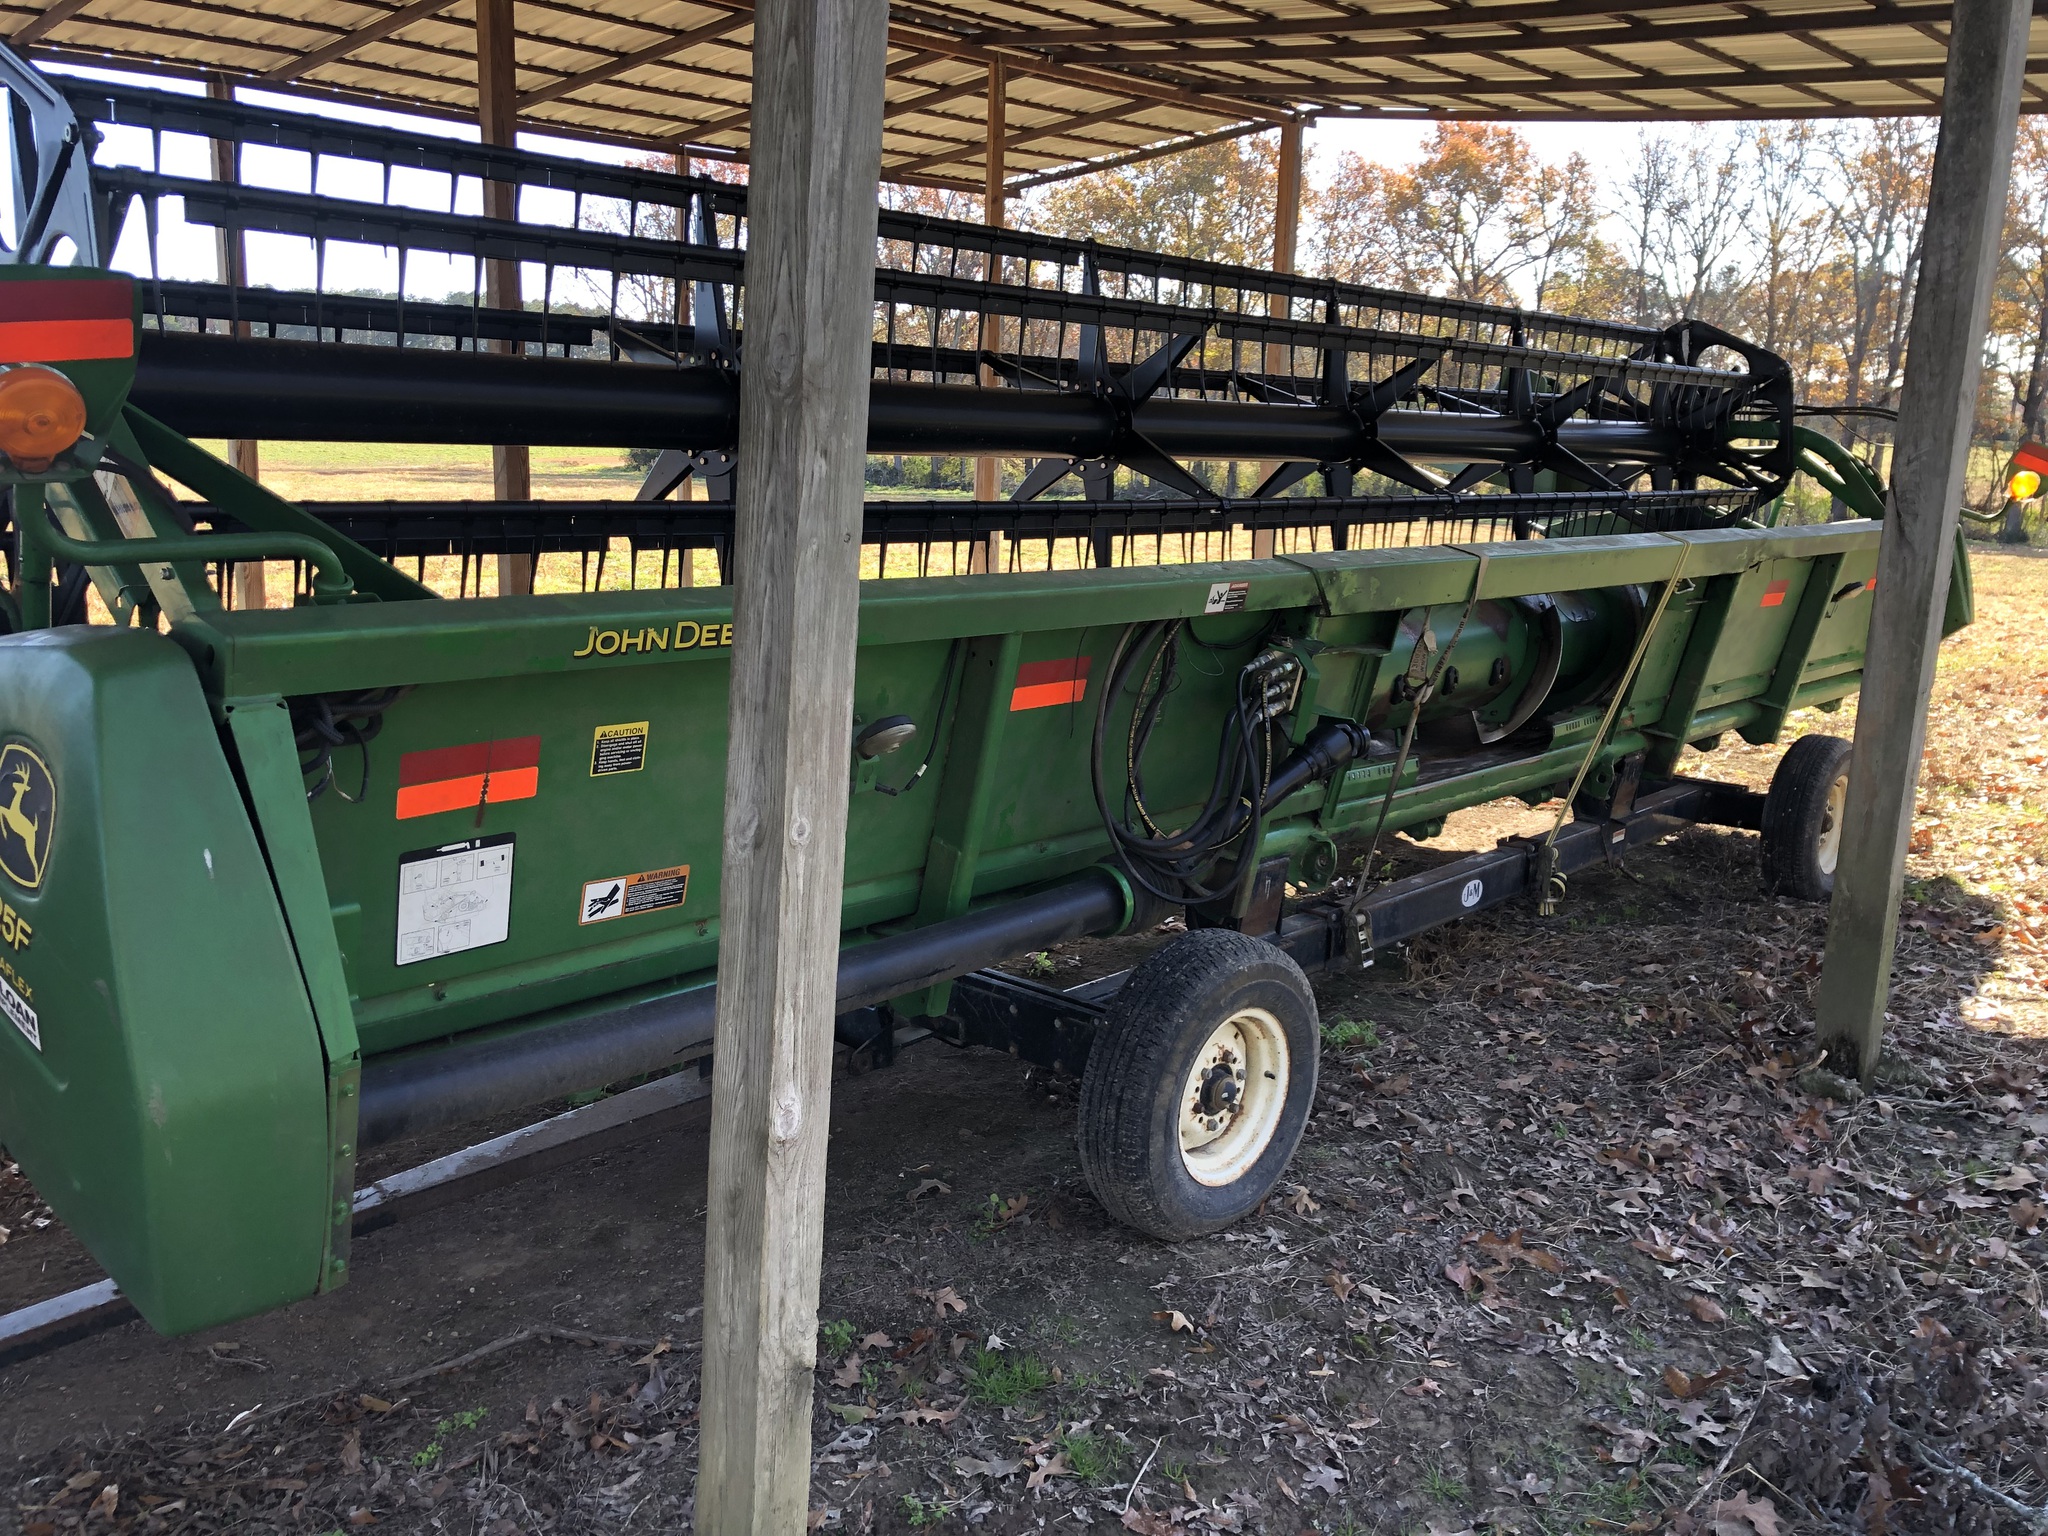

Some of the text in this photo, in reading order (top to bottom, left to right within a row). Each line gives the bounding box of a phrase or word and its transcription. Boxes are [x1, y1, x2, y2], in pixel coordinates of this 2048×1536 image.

[573, 625, 670, 657] JOHN
[607, 727, 644, 737] CAUTION
[646, 868, 681, 881] WARNING
[0, 896, 33, 951] 5F
